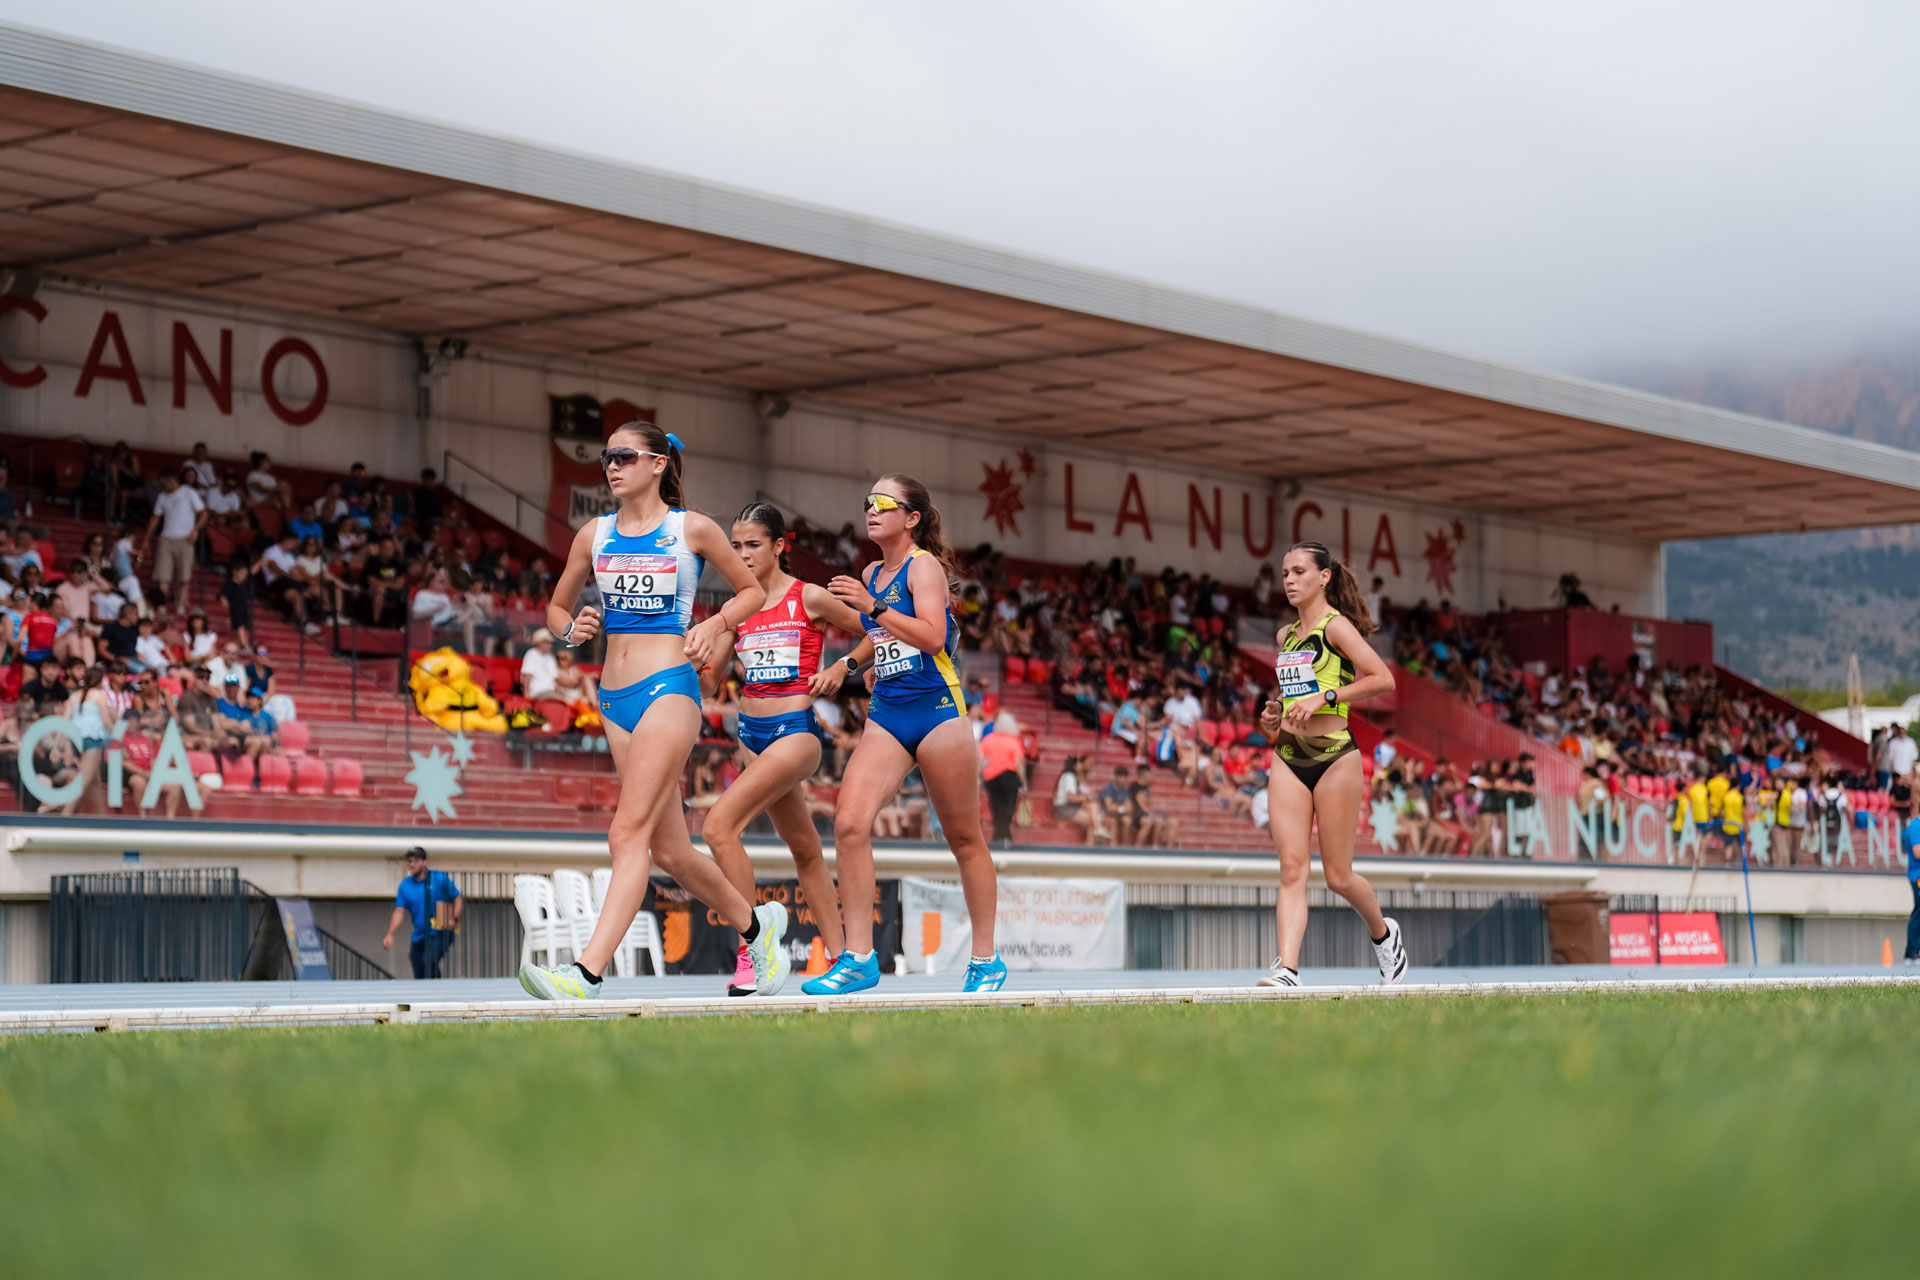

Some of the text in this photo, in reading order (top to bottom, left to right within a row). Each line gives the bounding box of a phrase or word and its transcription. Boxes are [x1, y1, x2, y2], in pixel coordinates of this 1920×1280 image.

[0, 294, 329, 427] CANO
[1064, 463, 1401, 576] LA NUCIA
[614, 574, 654, 594] 429
[769, 621, 807, 629] MARATHON
[754, 650, 776, 666] 24
[1280, 666, 1301, 683] 444
[1506, 797, 1552, 858] LA
[1821, 813, 1856, 866] LA
[1034, 909, 1108, 925] VALENCIANA
